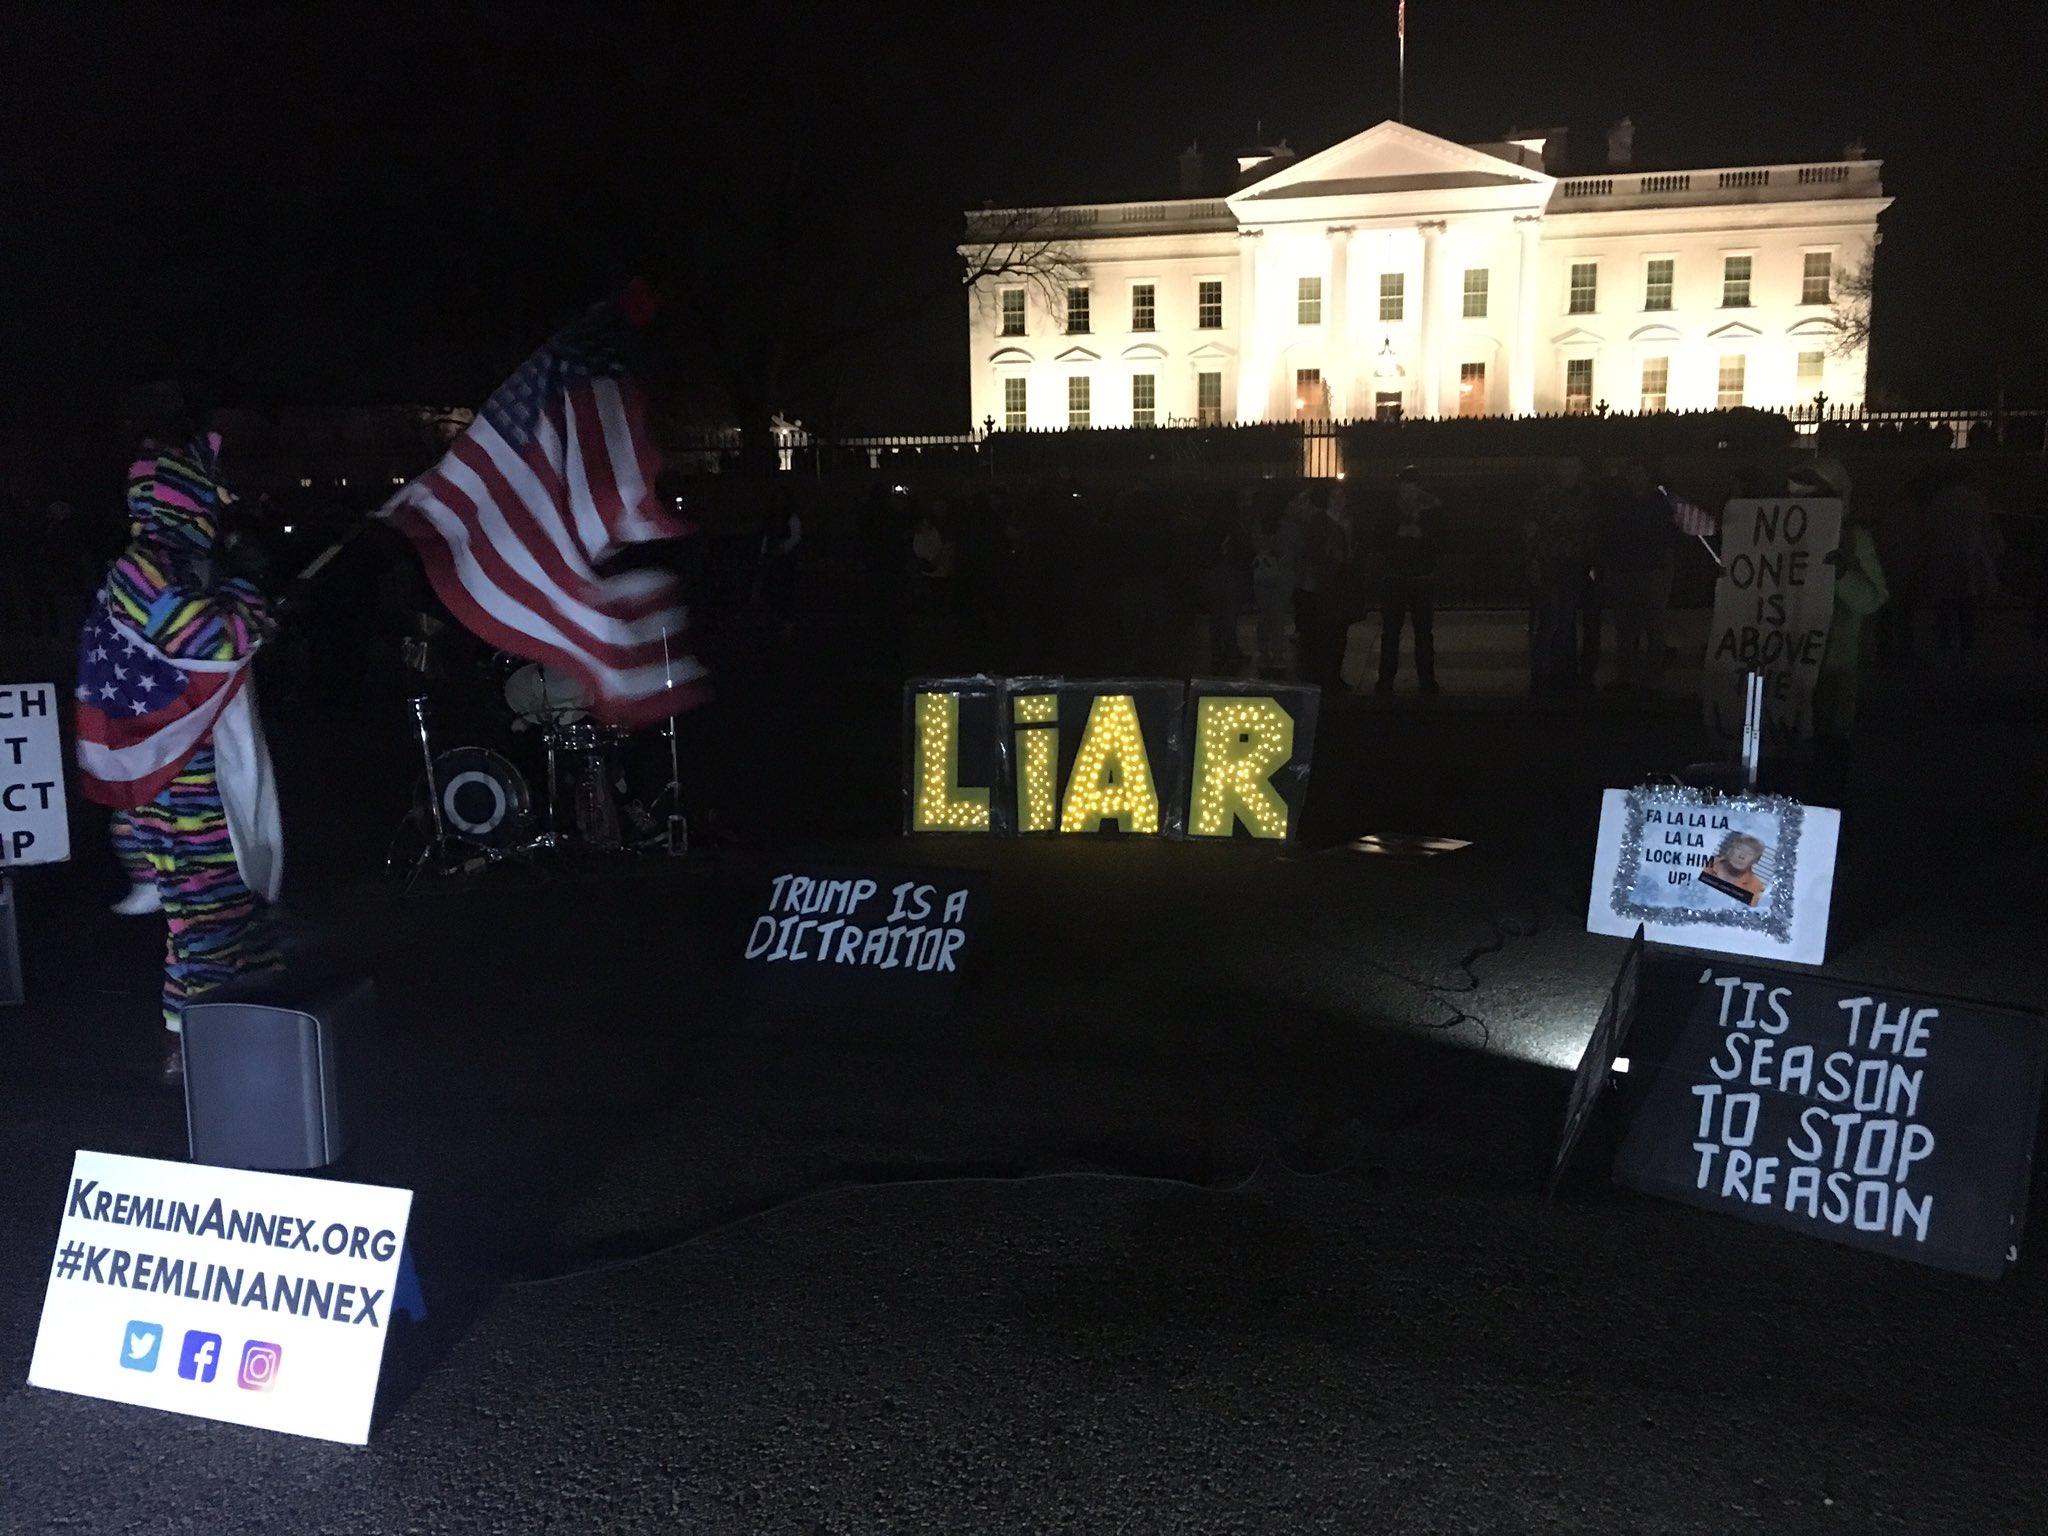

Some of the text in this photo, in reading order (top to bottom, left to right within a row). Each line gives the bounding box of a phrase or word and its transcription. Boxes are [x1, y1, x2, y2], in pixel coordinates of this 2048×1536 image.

[1753, 504, 1807, 546] NO
[1730, 550, 1809, 589] ONE
[1756, 593, 1786, 626] IS
[1714, 625, 1824, 666] ABOVE
[2, 782, 54, 811] CT
[1646, 810, 1729, 830] FA LA LA LA
[1665, 831, 1704, 847] LA LA
[1645, 849, 1715, 868] LOCK HIM
[1668, 871, 1692, 886] UP!
[768, 873, 969, 924] TRUMP IS A
[743, 914, 967, 973] DICTRAITOR
[1837, 996, 1940, 1058] THE
[1709, 1031, 1924, 1118] SEASON
[1691, 1084, 1936, 1184] TO STOP
[1692, 1142, 1934, 1243] TREASON
[56, 1240, 386, 1328] #KREMLINANNEX
